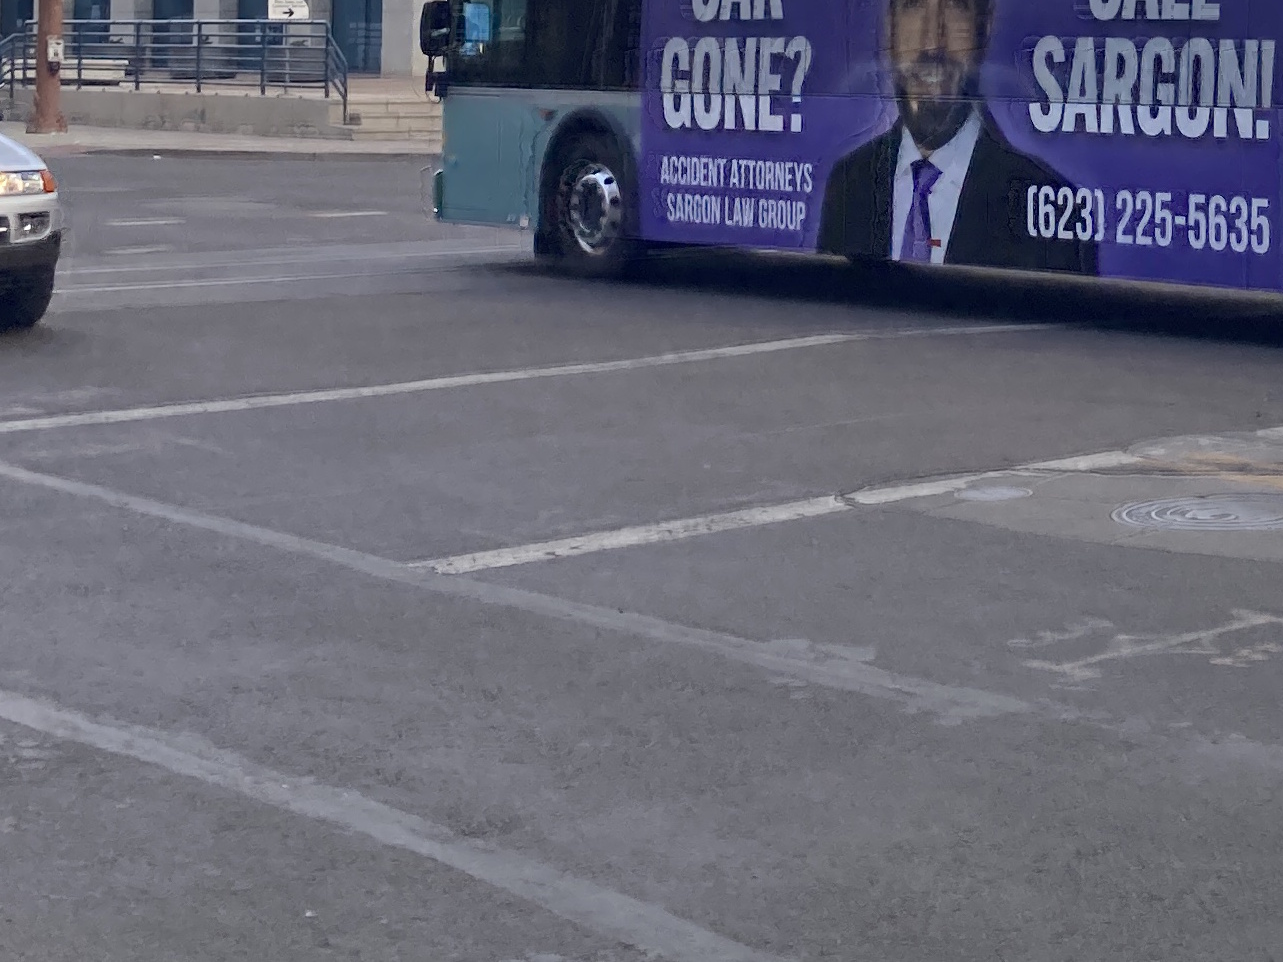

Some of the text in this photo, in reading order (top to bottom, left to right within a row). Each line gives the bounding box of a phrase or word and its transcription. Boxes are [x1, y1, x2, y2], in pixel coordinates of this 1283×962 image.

[660, 36, 812, 133] GONE?
[1029, 35, 1275, 140] SARGON!
[660, 156, 813, 193] ACCIDENT ATTORNEYS
[667, 193, 806, 231] SARGON LAW GROUP
[1027, 185, 1271, 255] (623) 225-5635
